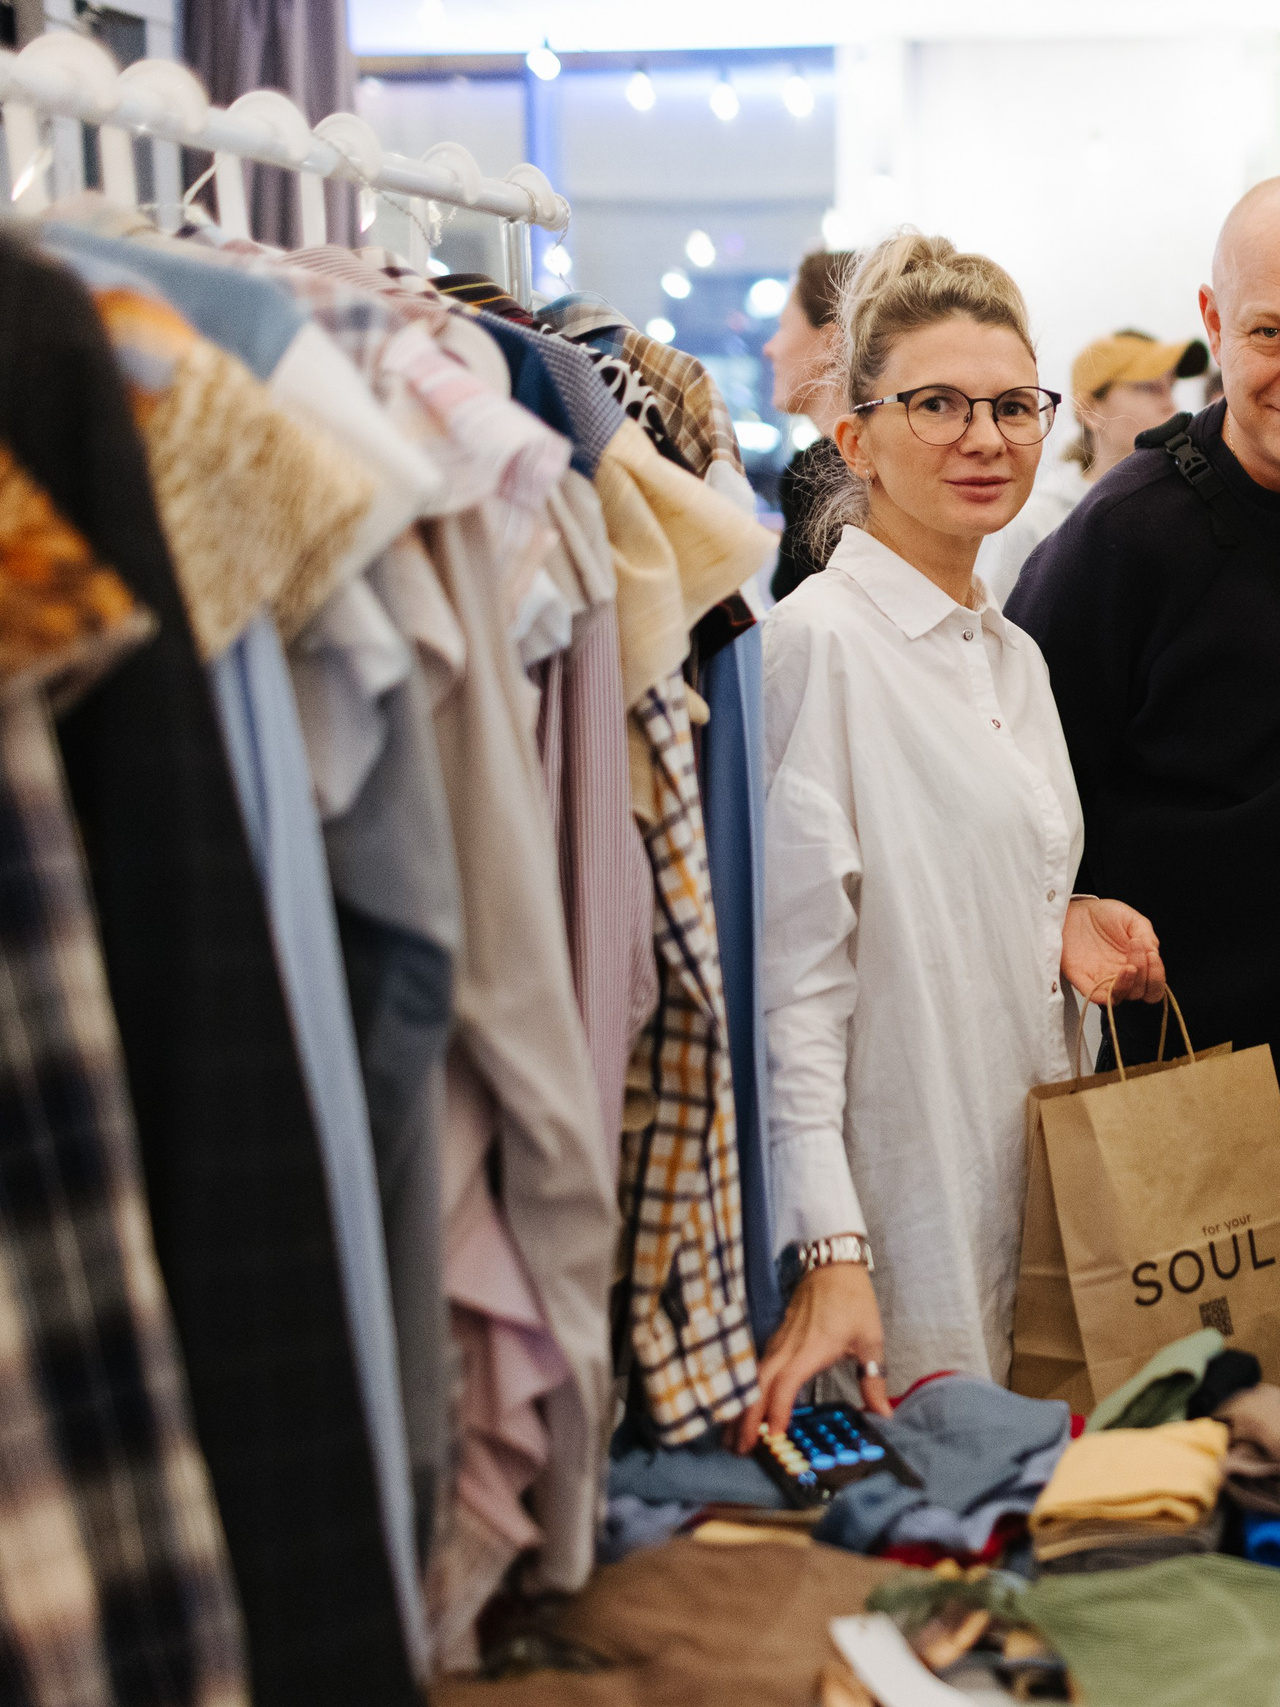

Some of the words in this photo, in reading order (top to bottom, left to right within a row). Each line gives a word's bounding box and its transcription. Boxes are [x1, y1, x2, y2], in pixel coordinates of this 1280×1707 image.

[1202, 1224, 1221, 1236] for
[1223, 1213, 1251, 1232] your
[1131, 1228, 1276, 1307] SOUL
